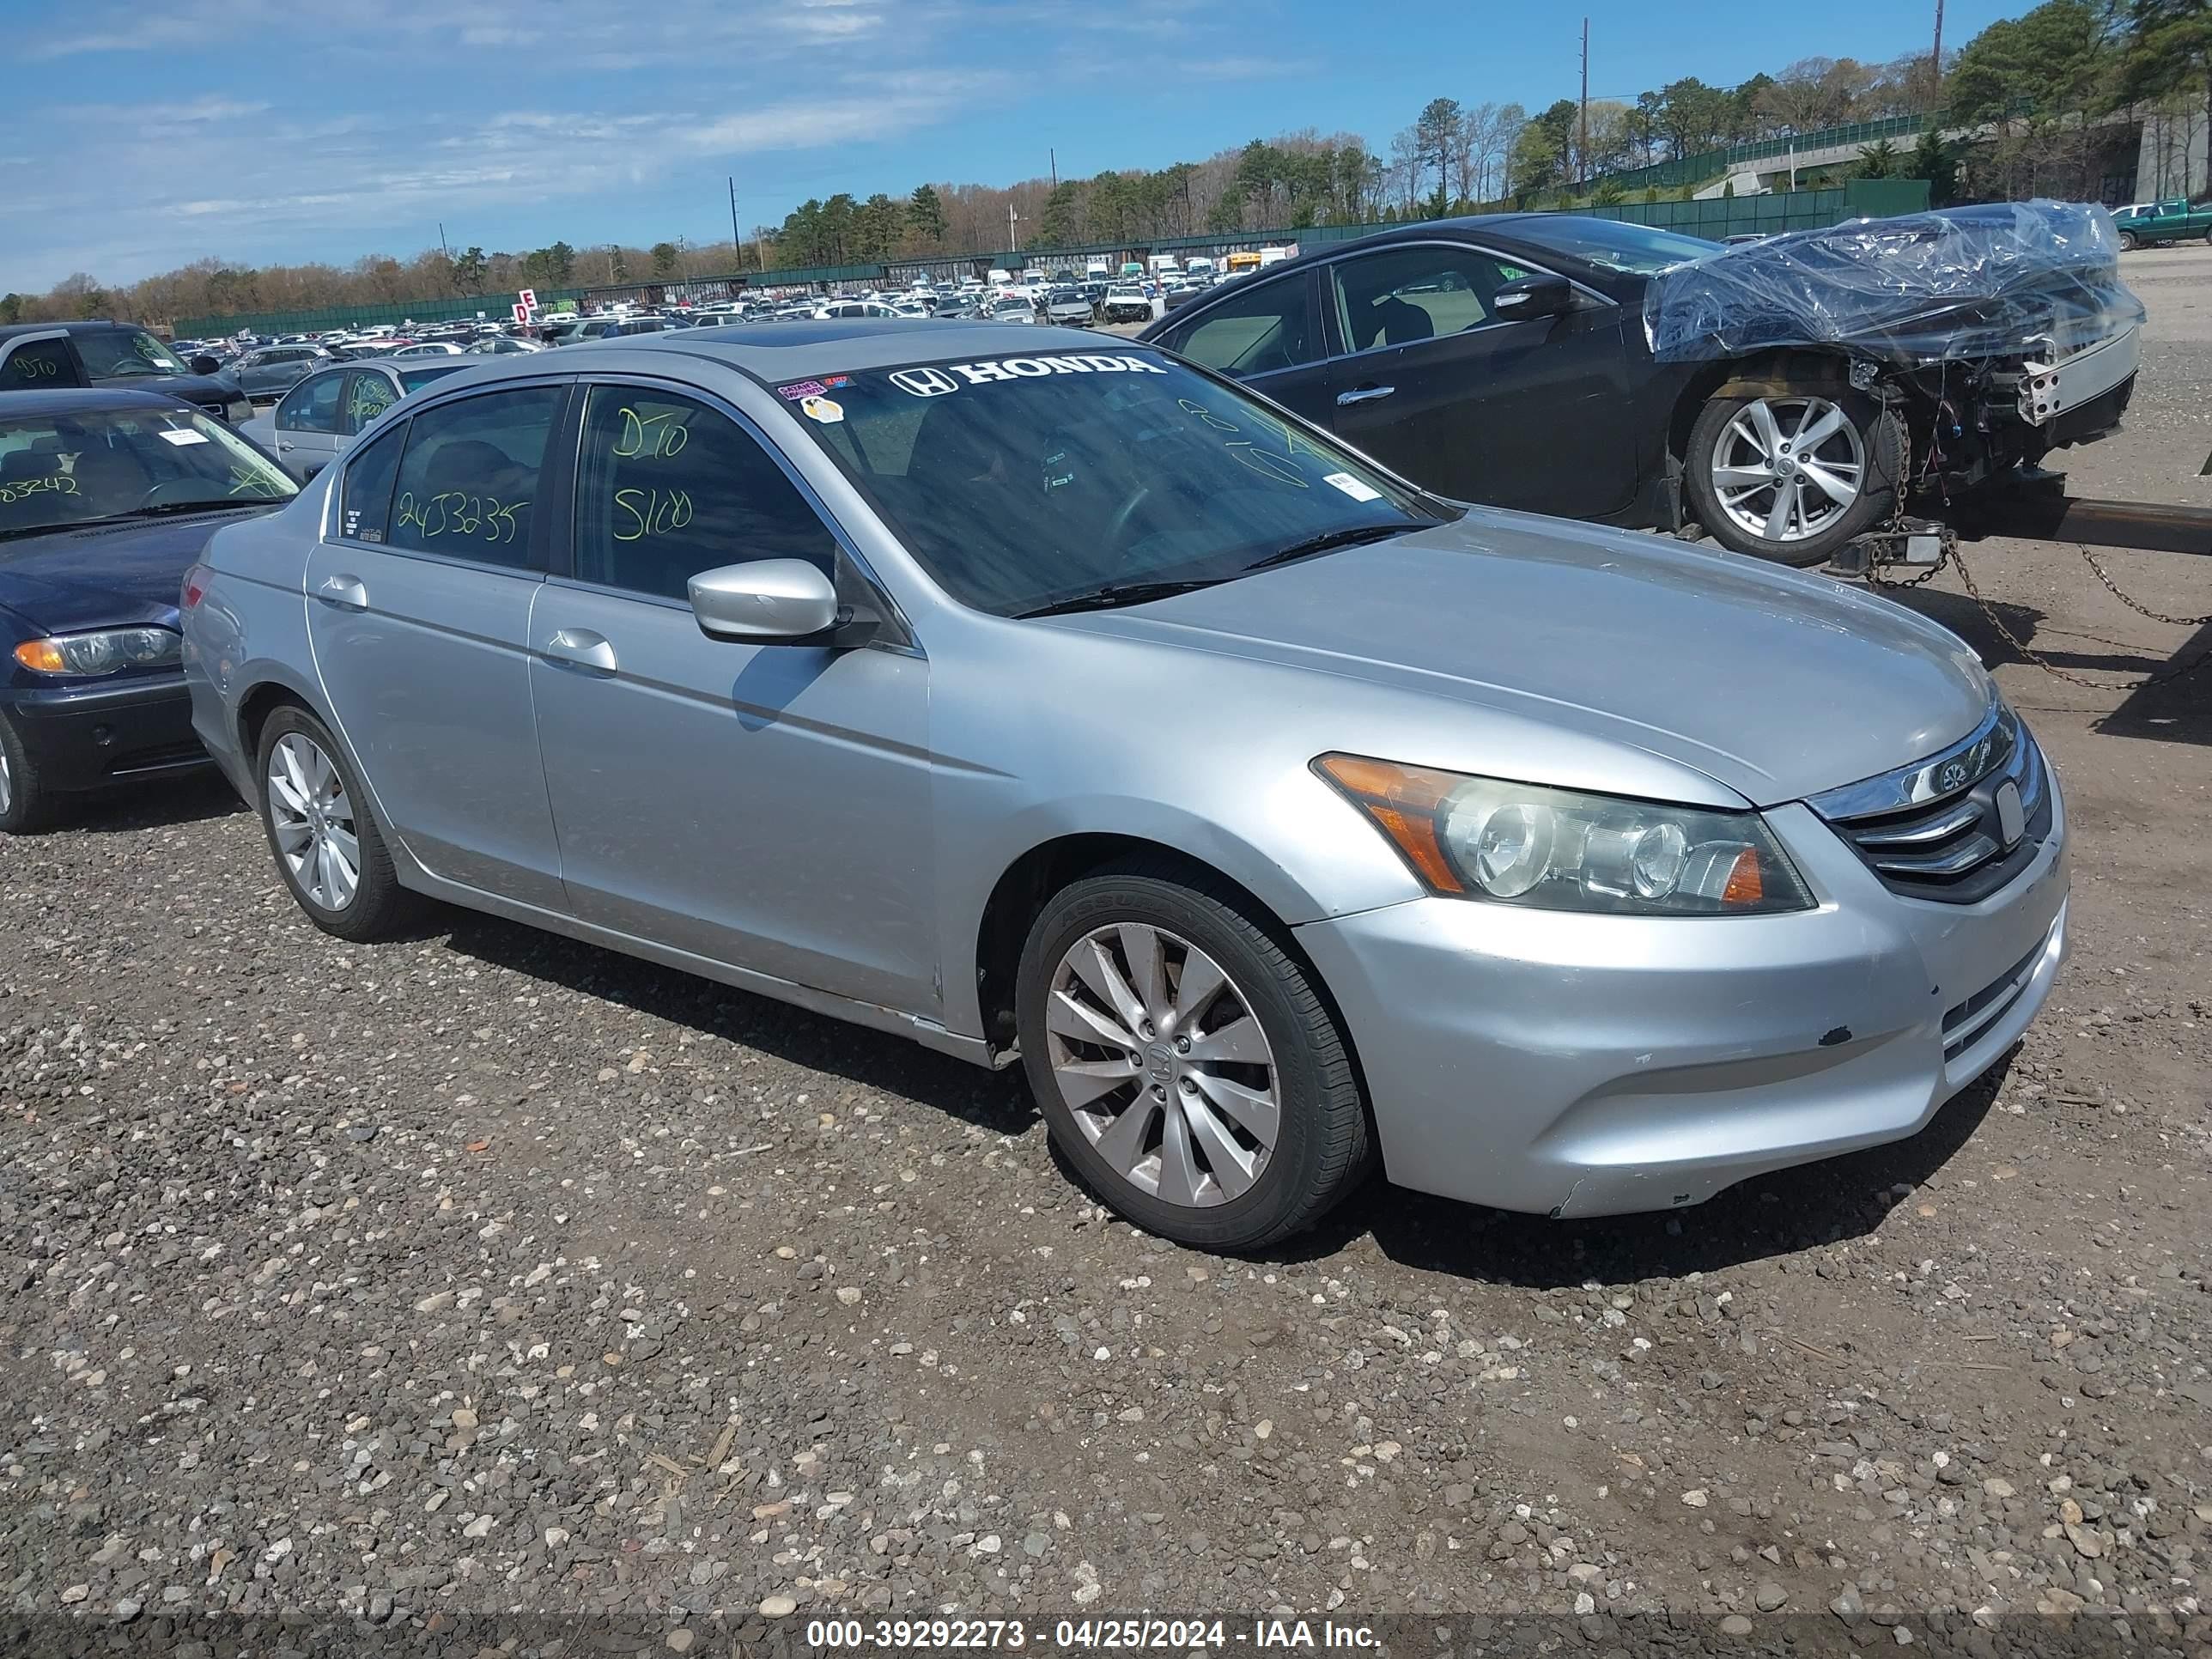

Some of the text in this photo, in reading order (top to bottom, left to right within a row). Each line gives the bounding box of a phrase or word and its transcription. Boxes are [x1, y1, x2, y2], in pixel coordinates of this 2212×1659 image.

[522, 293, 535, 308] E
[517, 305, 527, 322] D
[948, 356, 1169, 385] HONDA
